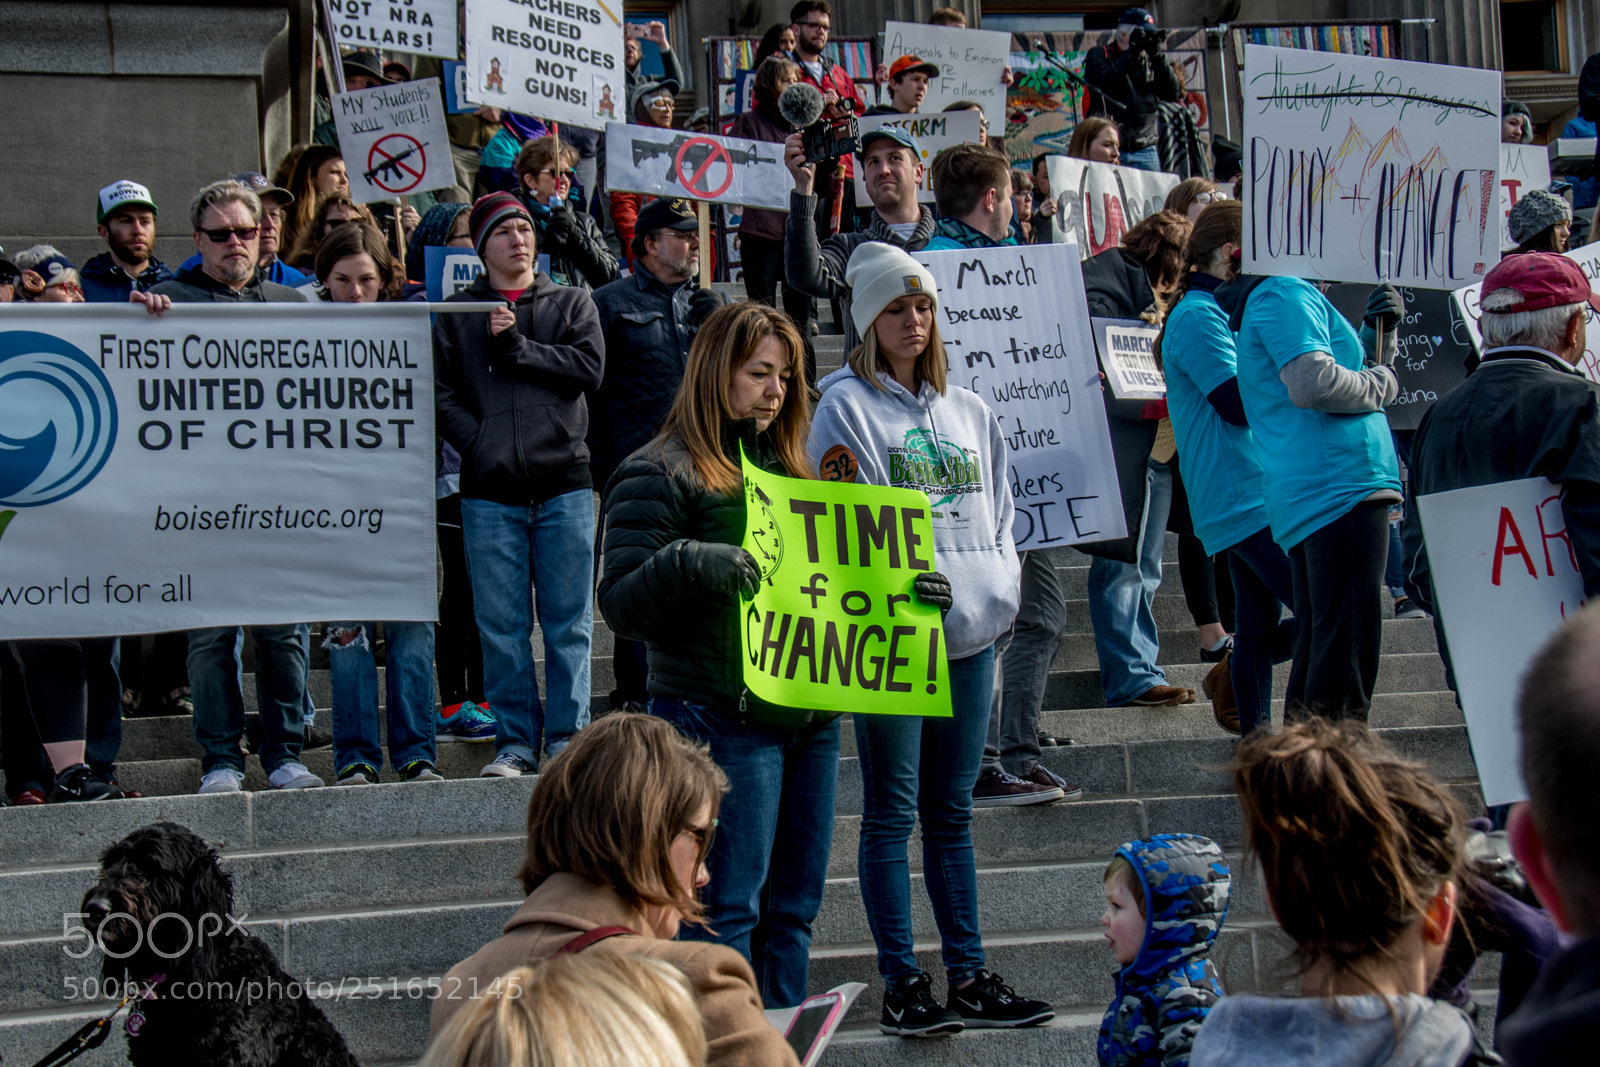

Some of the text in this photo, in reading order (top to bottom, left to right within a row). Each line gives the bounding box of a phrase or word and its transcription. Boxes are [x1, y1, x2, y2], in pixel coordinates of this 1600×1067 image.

[329, 0, 433, 27] NOT NRA
[508, 0, 601, 25] CHERS
[529, 12, 581, 40] NEED
[492, 25, 615, 69] RESOURCES
[890, 32, 1003, 64] Appeals to Emotion
[536, 58, 577, 82] NOT
[940, 64, 956, 76] re
[341, 86, 430, 115] My Students
[525, 77, 587, 106] GUNS!
[941, 77, 995, 97] Fallacies
[351, 103, 430, 134] WILL VOTE!!
[1399, 86, 1492, 126] prayers
[1251, 136, 1332, 261] POLICY
[1375, 162, 1496, 289] CHANGE!
[957, 255, 1037, 289] March
[944, 305, 1022, 324] because
[100, 334, 418, 369] FIRST CONGREGATIONAL
[1003, 323, 1067, 364] tired
[1111, 334, 1152, 353] MARCH
[1122, 370, 1158, 387] LIVES
[1405, 358, 1428, 371] for
[138, 377, 414, 411] UNITED CHURCH
[992, 377, 1071, 415] watching
[138, 418, 415, 451] OF CHRIST
[825, 453, 854, 482] 32
[888, 453, 983, 488] Basketball
[1011, 465, 1064, 499] ders
[155, 504, 383, 533] boisefirstucc.org
[789, 498, 930, 571] TIME
[103, 575, 150, 603] for
[161, 574, 192, 602] all
[800, 573, 911, 617] for
[747, 601, 940, 695] CHANGE!
